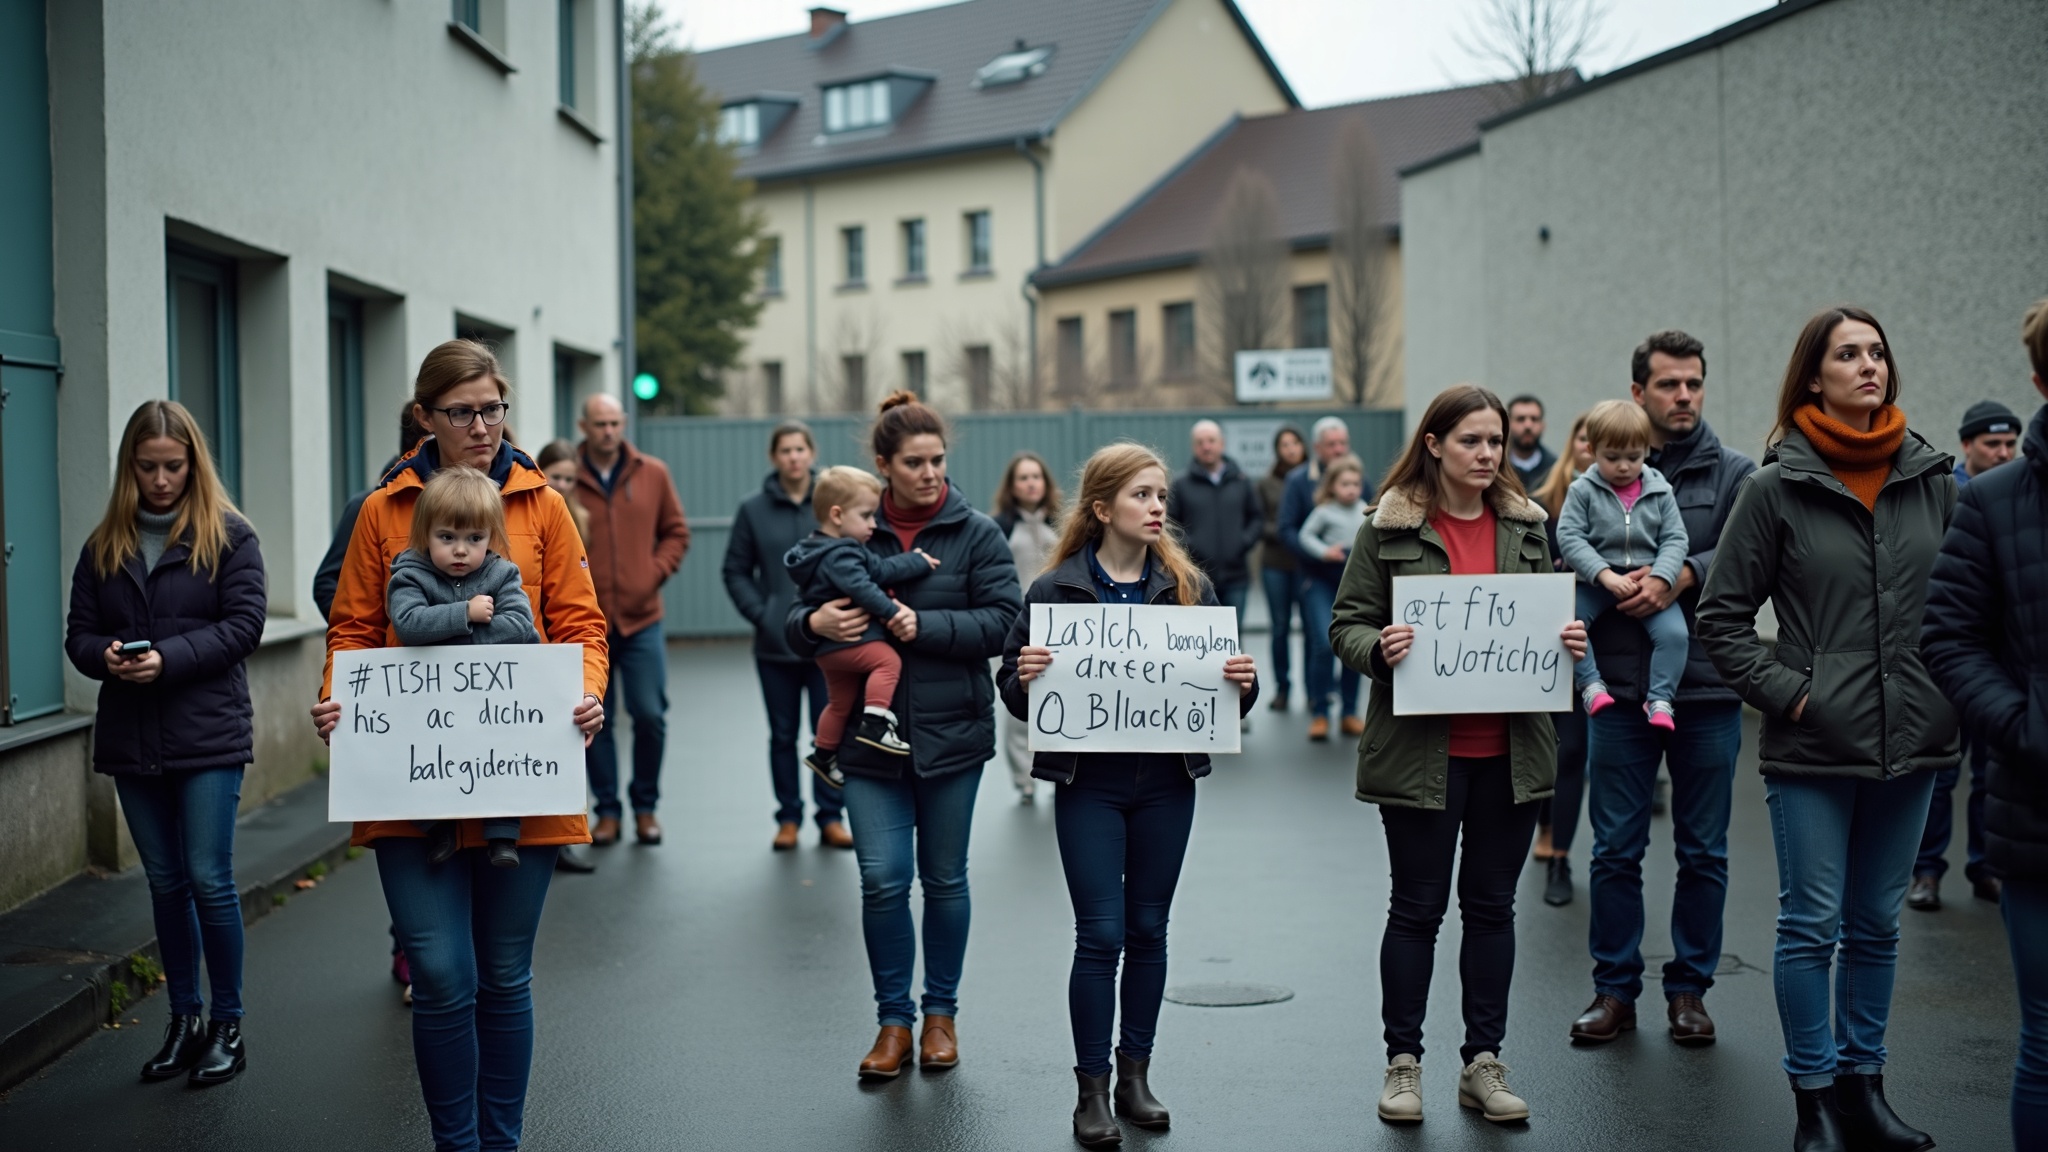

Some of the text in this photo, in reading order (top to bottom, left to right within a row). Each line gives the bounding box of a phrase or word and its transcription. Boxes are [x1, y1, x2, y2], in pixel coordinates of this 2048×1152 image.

[453, 660, 519, 693] SEXT
[354, 702, 391, 735] his
[426, 708, 455, 729] ac
